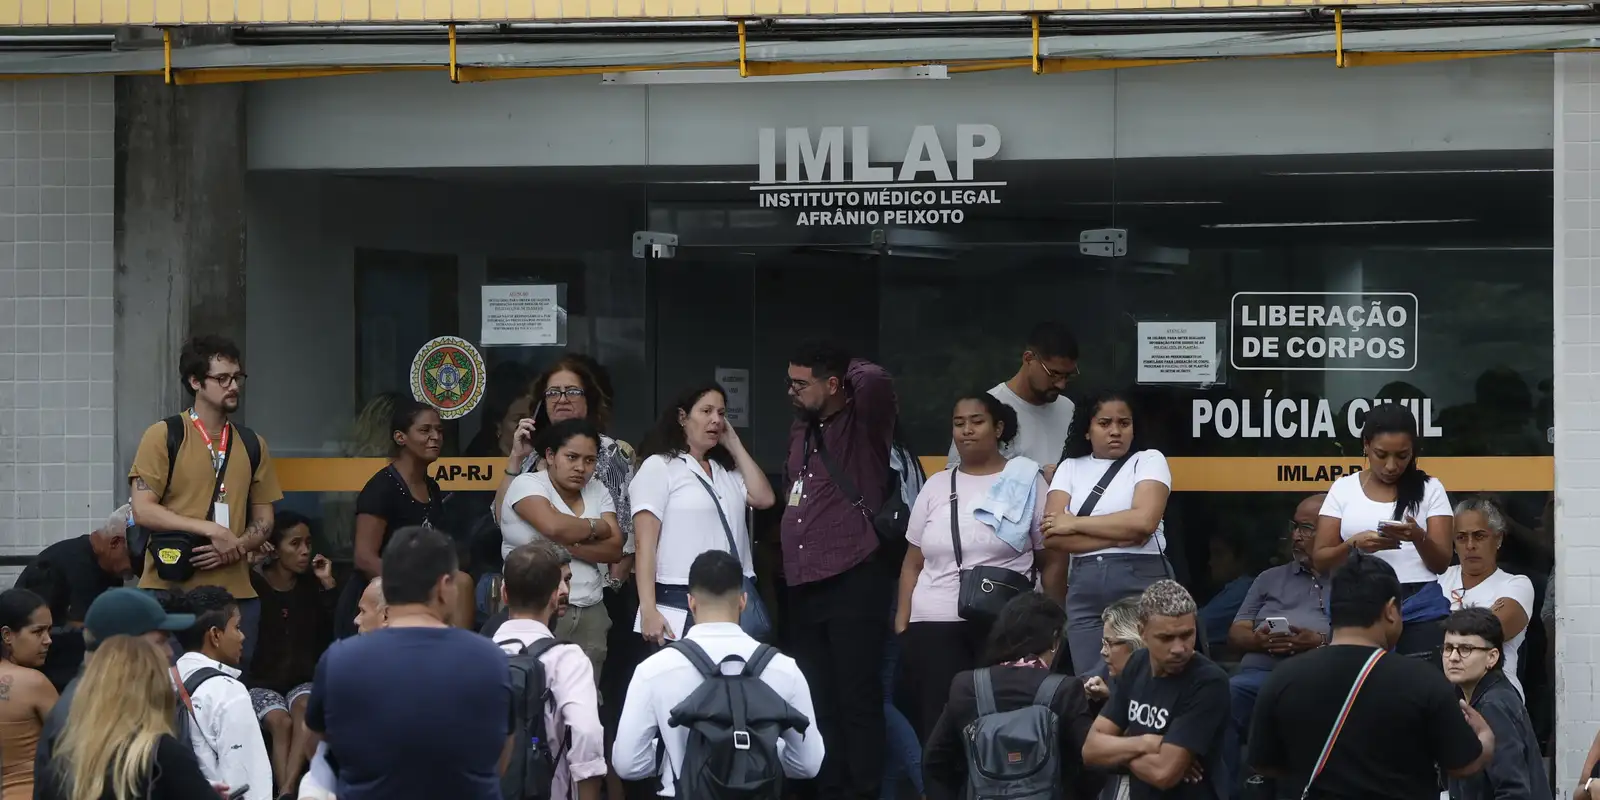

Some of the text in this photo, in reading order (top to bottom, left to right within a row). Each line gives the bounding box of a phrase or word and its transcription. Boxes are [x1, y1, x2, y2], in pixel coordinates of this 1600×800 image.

[758, 124, 1001, 183] IMLAP
[760, 188, 1001, 207] INSTITUTO MÉDICO LEGAL
[797, 208, 964, 225] AFRÂNIO PEIXOTO
[1242, 301, 1407, 332] LIBERAÇÃO
[1243, 337, 1406, 358] DE CORPOS
[1192, 389, 1442, 438] POLÍCIA CIL
[431, 465, 493, 481] AP-RJ
[1128, 699, 1169, 729] BOSS
